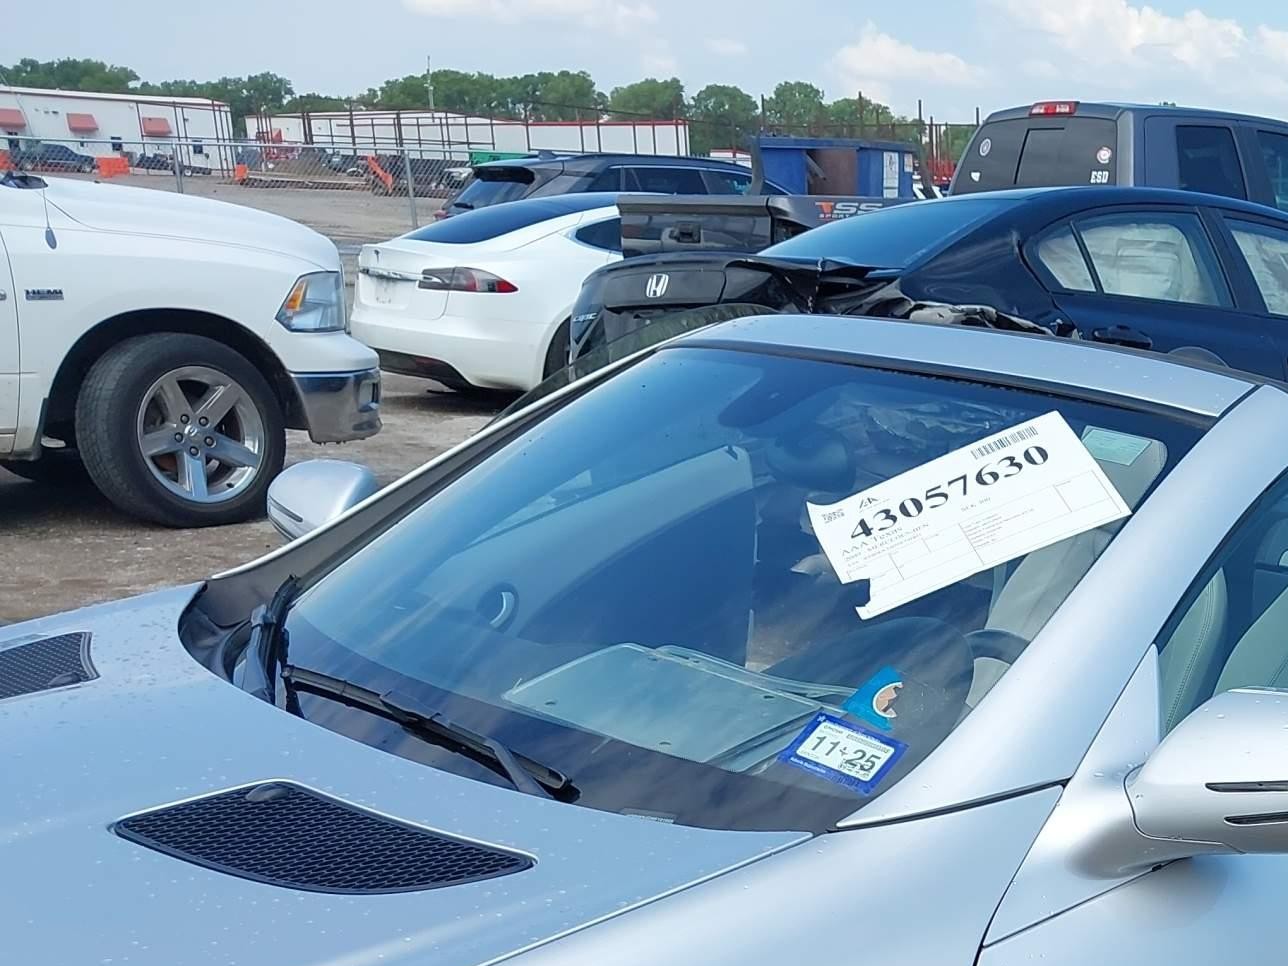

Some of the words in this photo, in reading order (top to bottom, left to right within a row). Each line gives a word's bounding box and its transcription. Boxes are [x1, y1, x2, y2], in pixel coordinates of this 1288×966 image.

[1090, 171, 1110, 184] ESD
[815, 201, 883, 215] TSS
[850, 445, 1049, 539] 43057630
[811, 735, 841, 757] 11
[844, 749, 882, 771] 25
